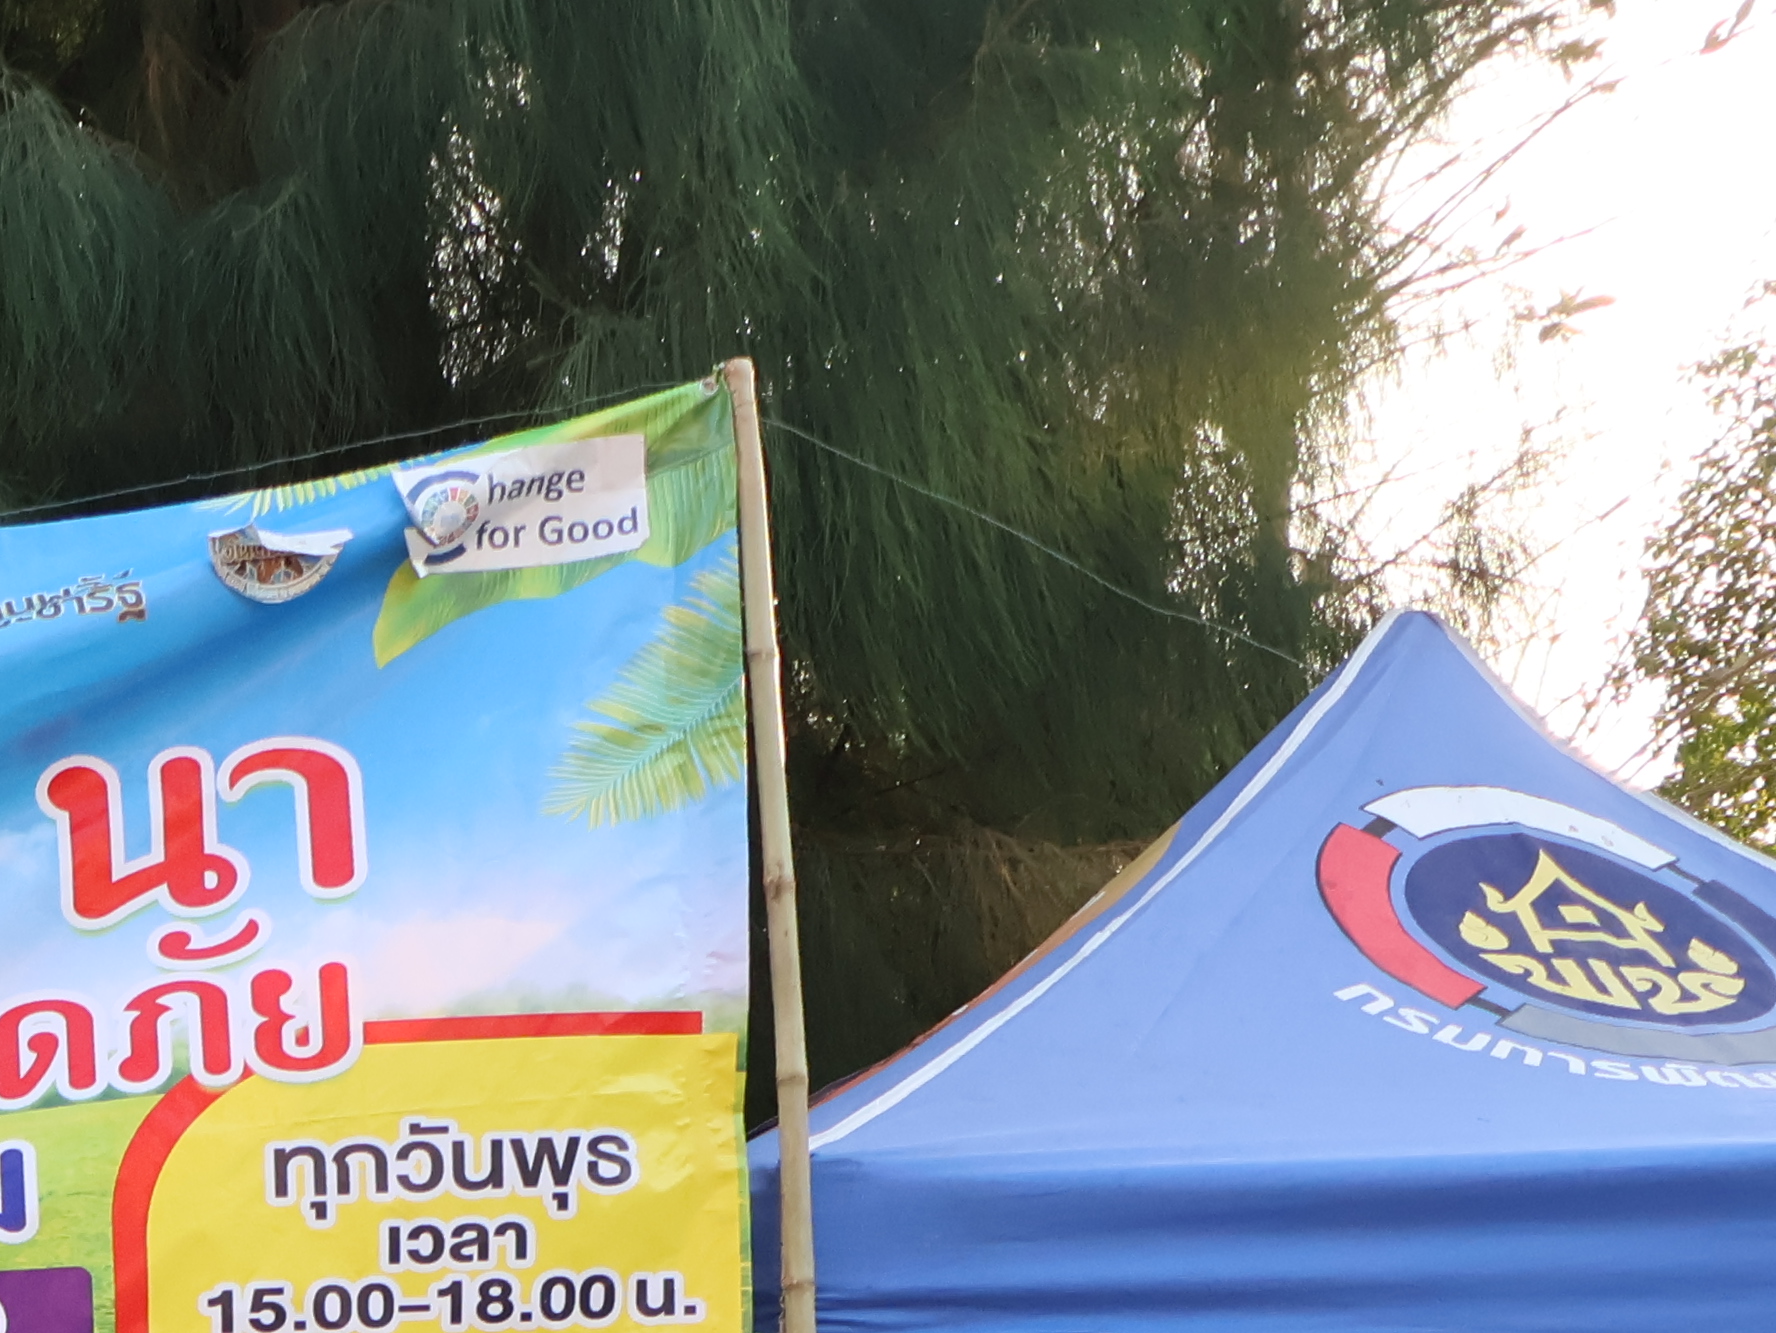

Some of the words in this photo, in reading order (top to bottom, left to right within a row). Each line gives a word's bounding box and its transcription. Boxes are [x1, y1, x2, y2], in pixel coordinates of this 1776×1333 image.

[476, 519, 526, 550] for
[538, 507, 639, 544] Good
[47, 750, 359, 915] นา
[273, 1123, 631, 1220] ทุกวันพุธ
[388, 1221, 527, 1262] เวลา
[207, 1275, 616, 1333] 15.00-18.00
[636, 1278, 697, 1315] น.
